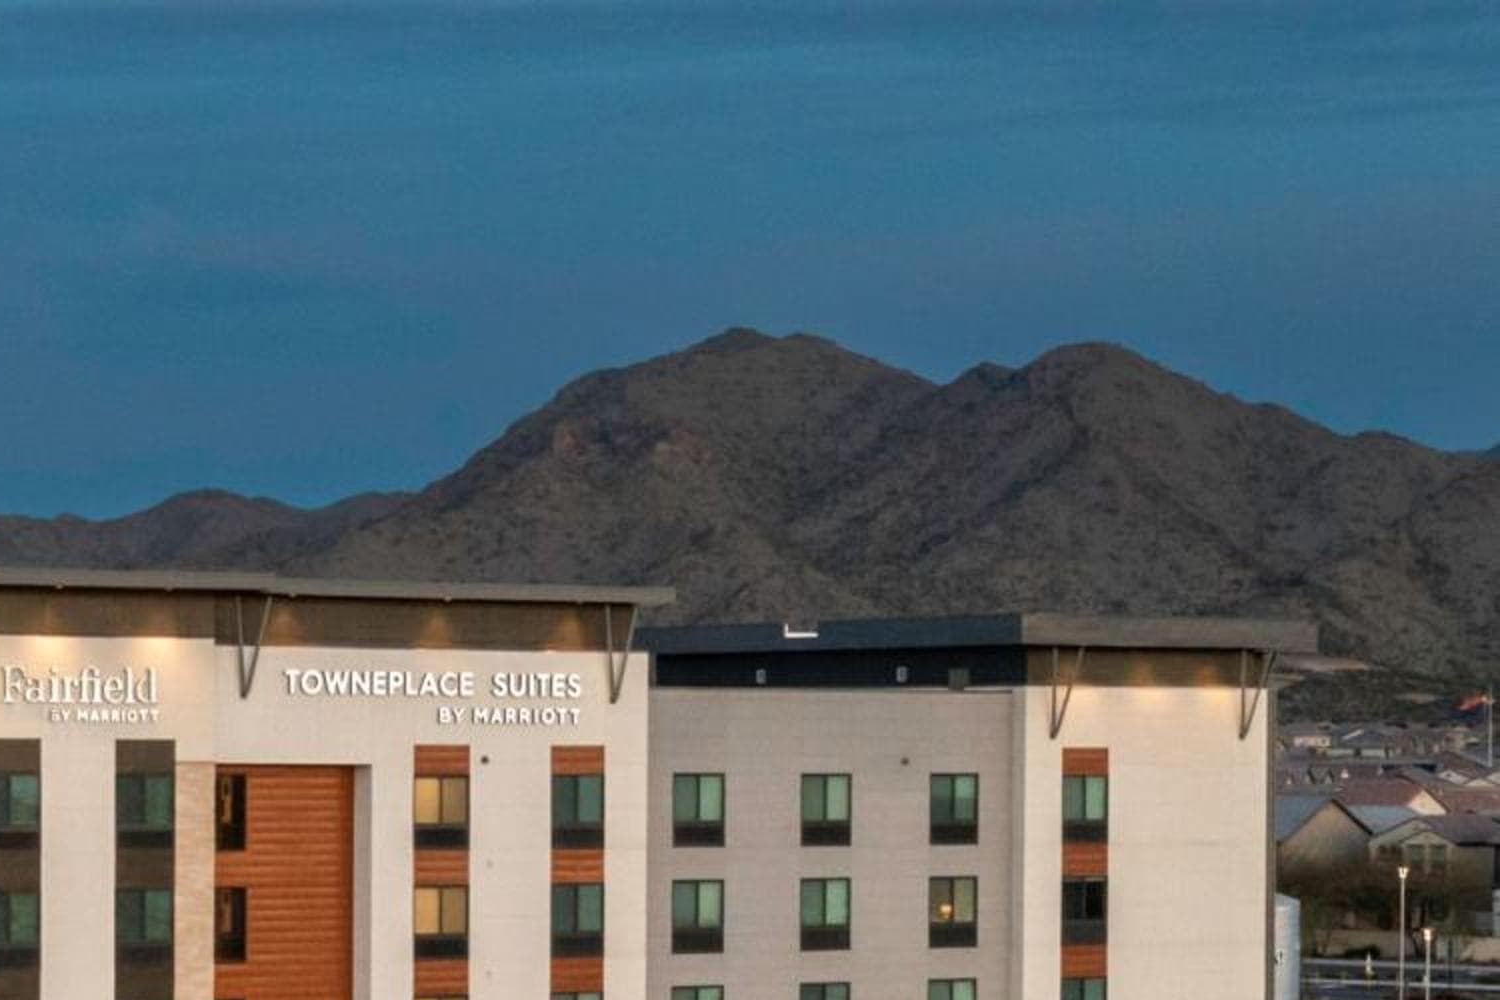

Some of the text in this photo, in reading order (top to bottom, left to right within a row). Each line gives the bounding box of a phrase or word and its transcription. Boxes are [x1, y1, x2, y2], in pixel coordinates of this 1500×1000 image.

[2, 664, 157, 703] Fairfield
[284, 669, 582, 698] TOWNEPLACE SUITES
[50, 708, 160, 723] BY MARRIOTT
[438, 706, 581, 726] BY MARRIOTT
